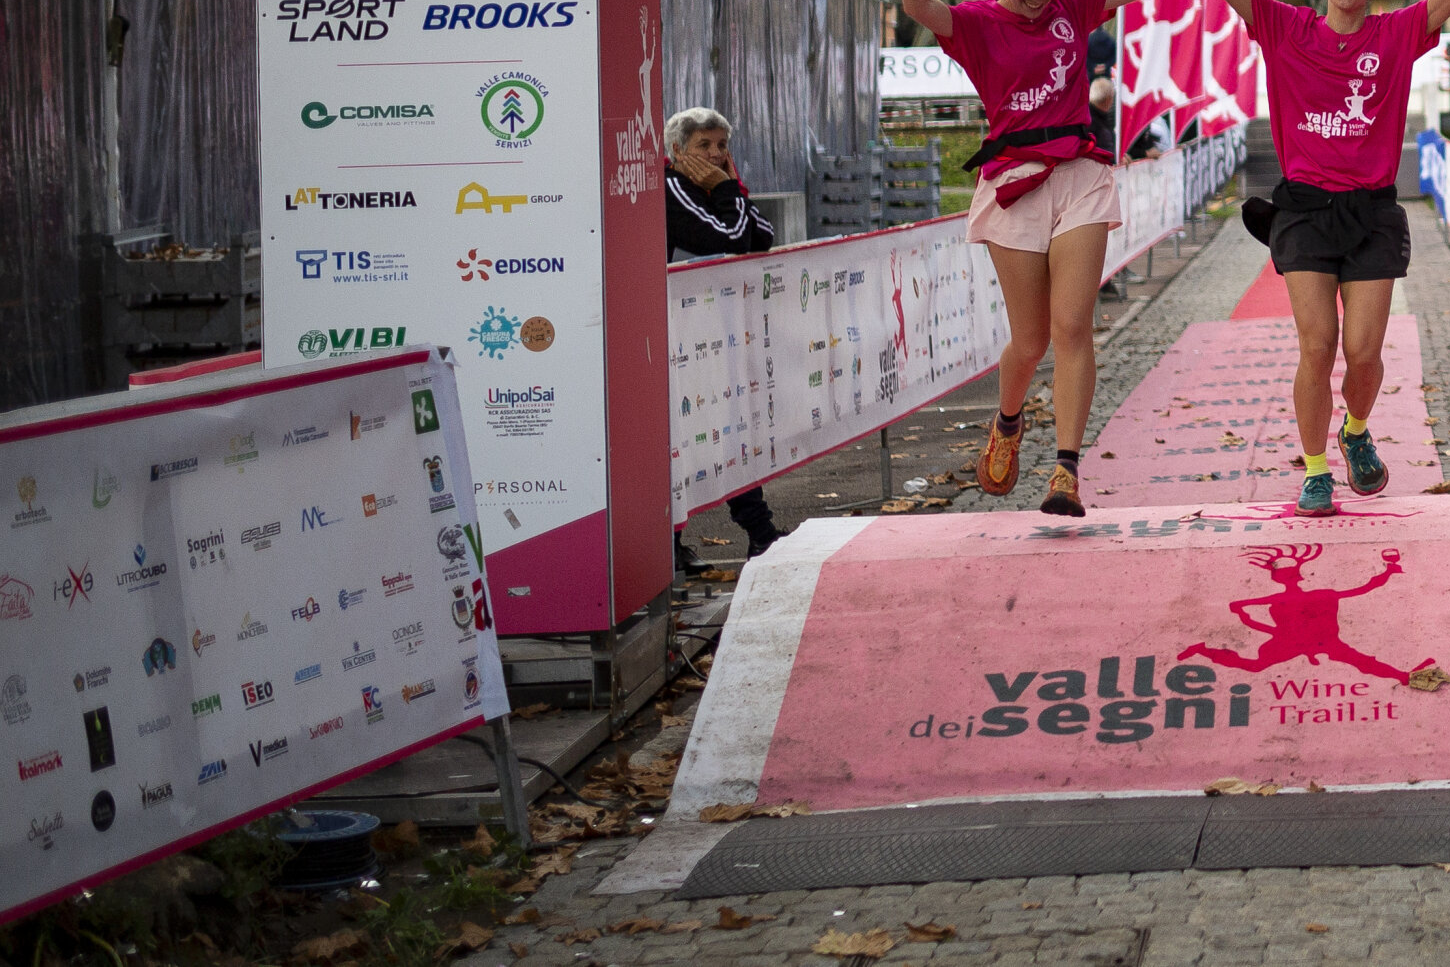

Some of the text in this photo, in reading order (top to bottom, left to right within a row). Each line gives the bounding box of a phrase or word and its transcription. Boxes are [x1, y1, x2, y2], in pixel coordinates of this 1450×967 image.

[423, 1, 579, 30] BROOKS
[289, 20, 389, 42] LAND
[476, 71, 549, 99] VALLE CAMONICA
[339, 104, 432, 120] COMISA
[1305, 112, 1342, 127] valle
[495, 139, 532, 149] SERVIZI
[616, 119, 641, 162] valle
[285, 187, 417, 211] LATTONERIA
[530, 194, 563, 204] GROUP
[332, 251, 371, 270] TIS
[333, 272, 409, 283] www.tis-srl.it
[489, 386, 554, 408] UnipolSai
[187, 529, 225, 553] Sagrini
[984, 656, 1217, 703] valle
[1269, 679, 1369, 700] Wine
[1269, 700, 1398, 725] Trail.it
